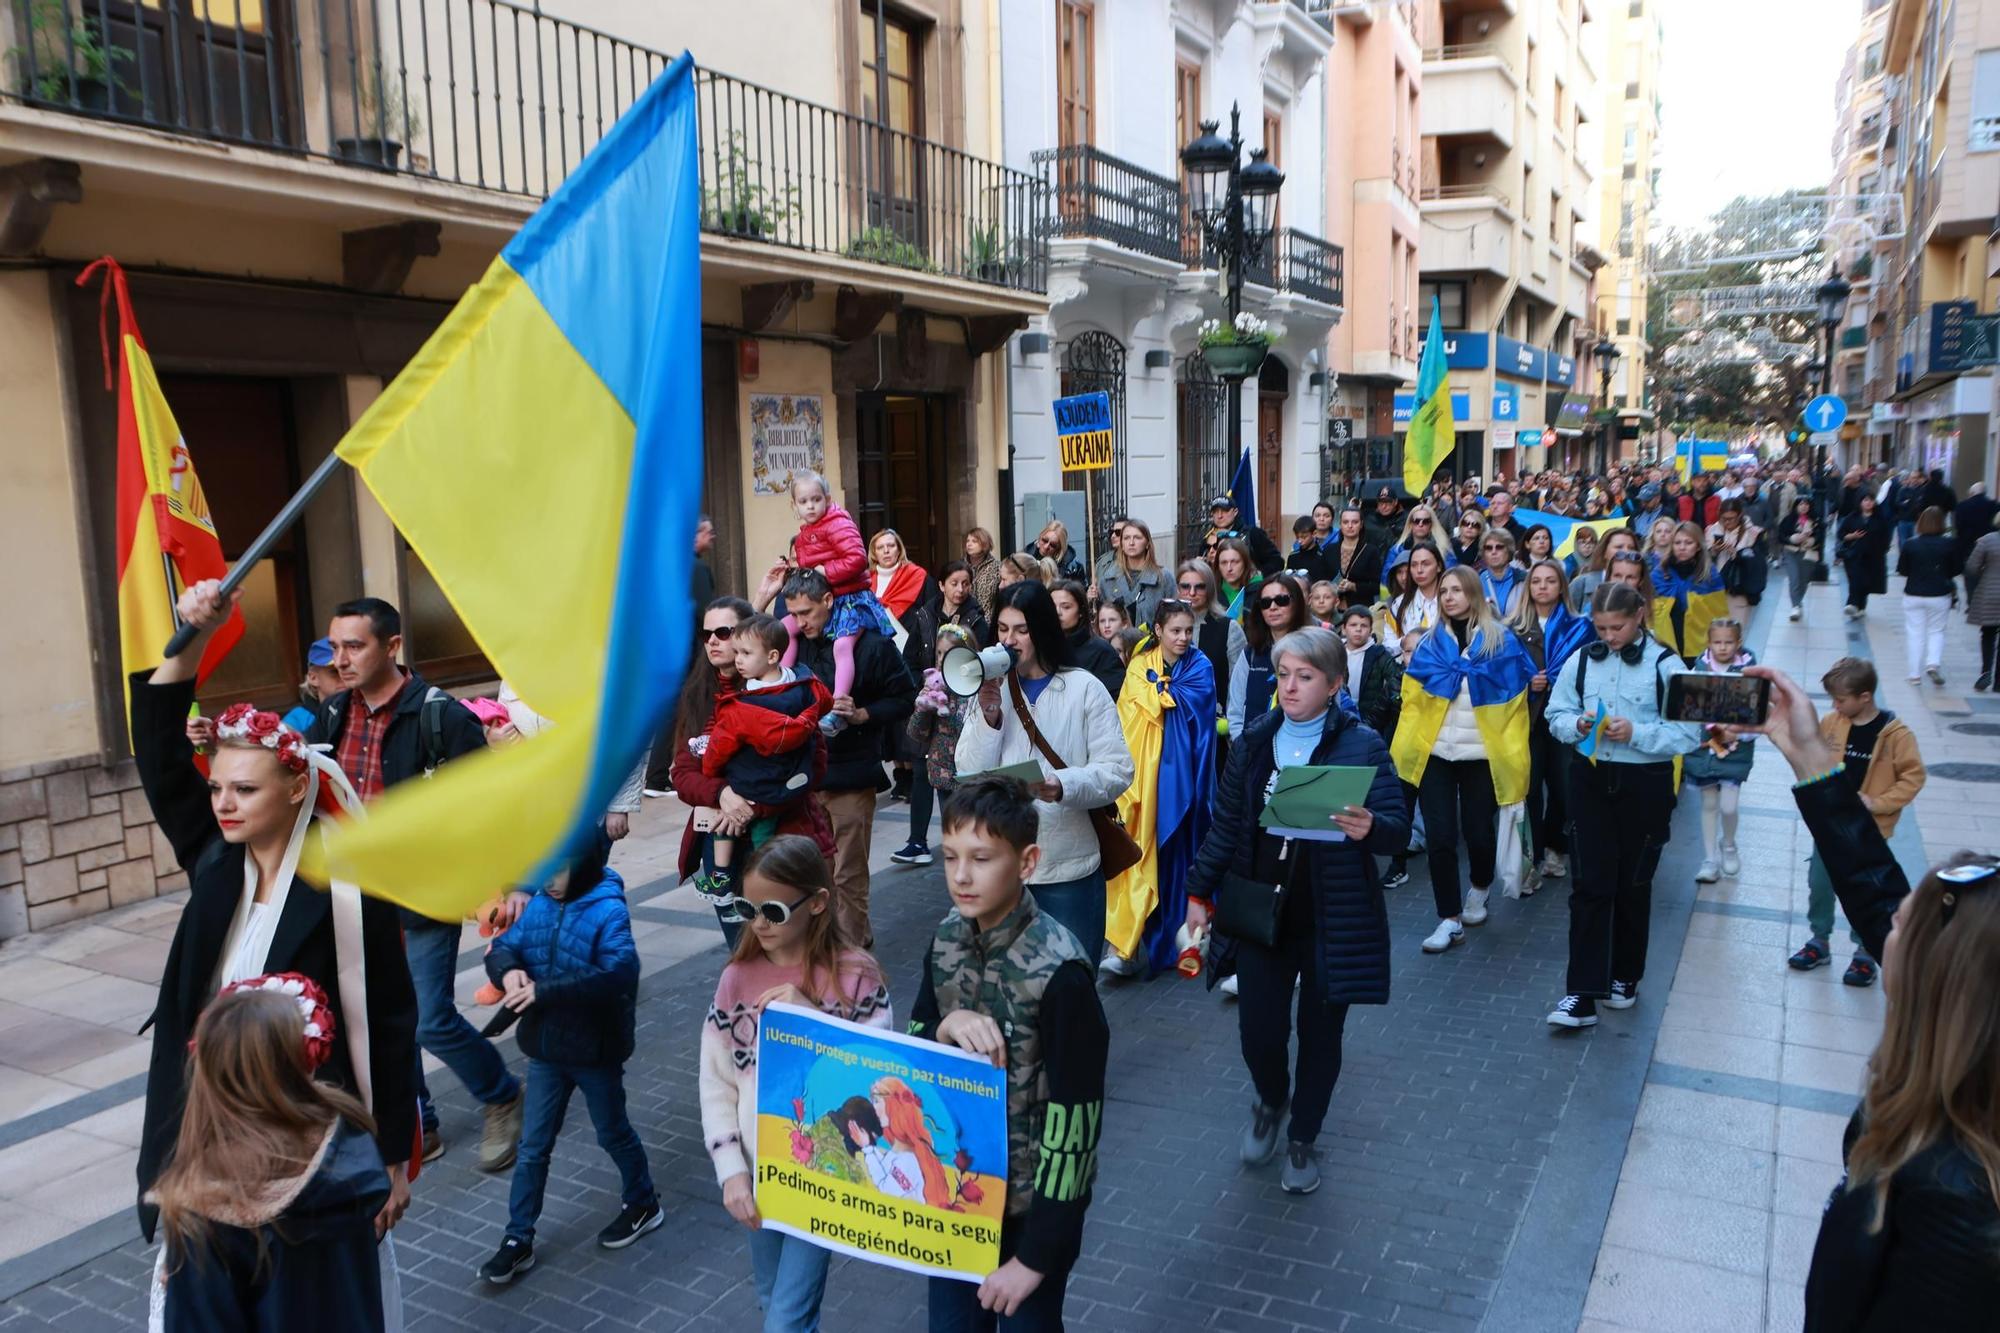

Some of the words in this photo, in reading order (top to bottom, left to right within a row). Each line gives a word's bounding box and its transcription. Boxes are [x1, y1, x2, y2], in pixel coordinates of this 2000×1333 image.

[768, 429, 809, 447] BIBLIOTECA
[1057, 400, 1100, 431] AJUDEM
[768, 452, 808, 470] MUNICIPAL
[1060, 429, 1112, 468] UCRAÏNA
[765, 1027, 813, 1051] ¡Ucrania
[815, 1041, 859, 1066] protege
[860, 1056, 909, 1077] vuestra
[911, 1068, 935, 1083] paz
[936, 1074, 1000, 1100] también!
[1043, 1100, 1101, 1152] DAY
[1034, 1145, 1096, 1202] TIM
[758, 1165, 836, 1203] ¡Pedimos
[841, 1192, 897, 1220] armas
[902, 1209, 945, 1234] para
[810, 1216, 953, 1267] protegiéndoos!
